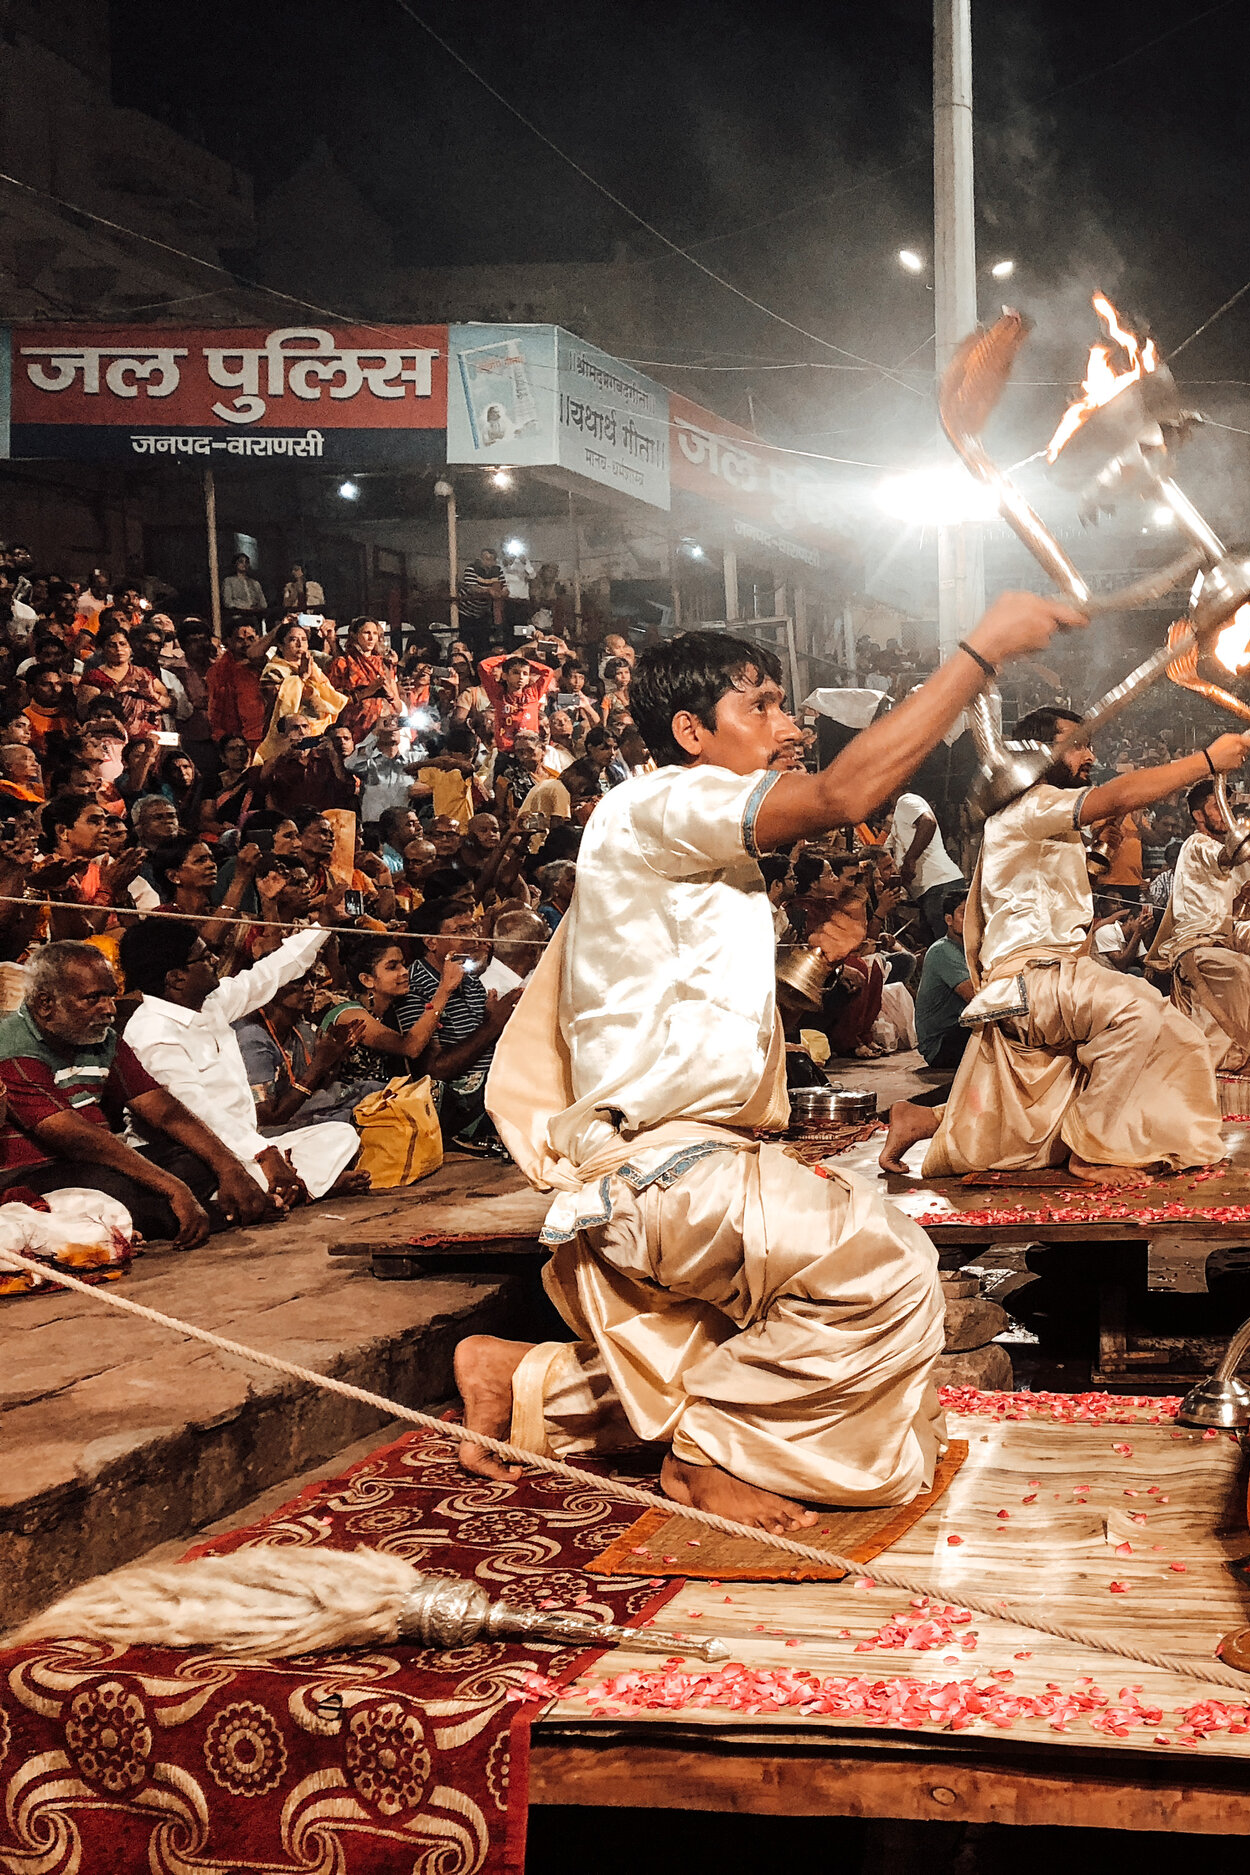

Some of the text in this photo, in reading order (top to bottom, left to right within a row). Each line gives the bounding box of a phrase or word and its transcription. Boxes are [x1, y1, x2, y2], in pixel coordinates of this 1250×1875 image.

[20, 346, 189, 398] जल
[202, 327, 439, 424] पुलिस
[130, 429, 325, 458] जनपद-वाराणसी
[673, 415, 764, 492] जल
